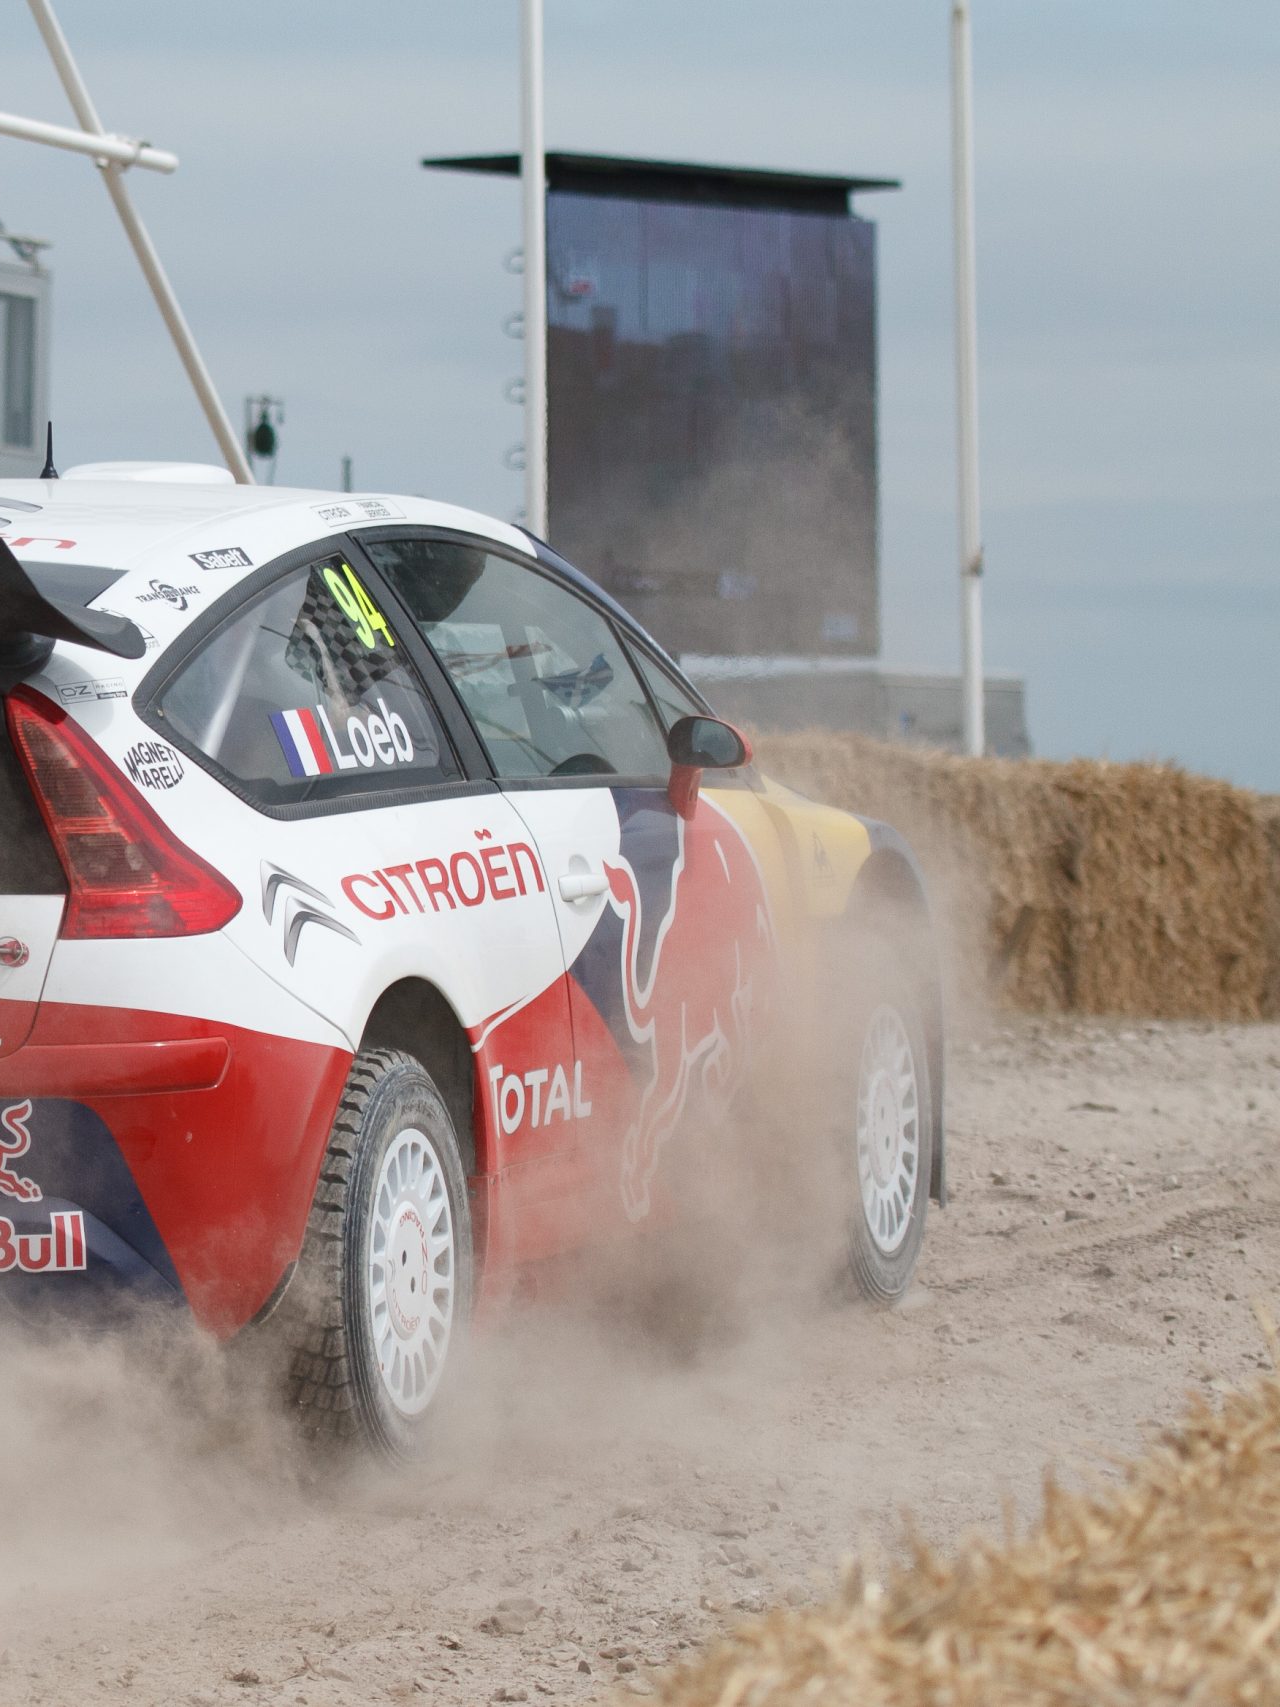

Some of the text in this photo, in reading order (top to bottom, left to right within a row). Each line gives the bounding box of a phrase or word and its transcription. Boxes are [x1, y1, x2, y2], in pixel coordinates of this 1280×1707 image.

[195, 549, 248, 569] Sabelt
[322, 564, 395, 649] 94
[316, 698, 414, 770] Loeb
[341, 829, 545, 921] CITROËN
